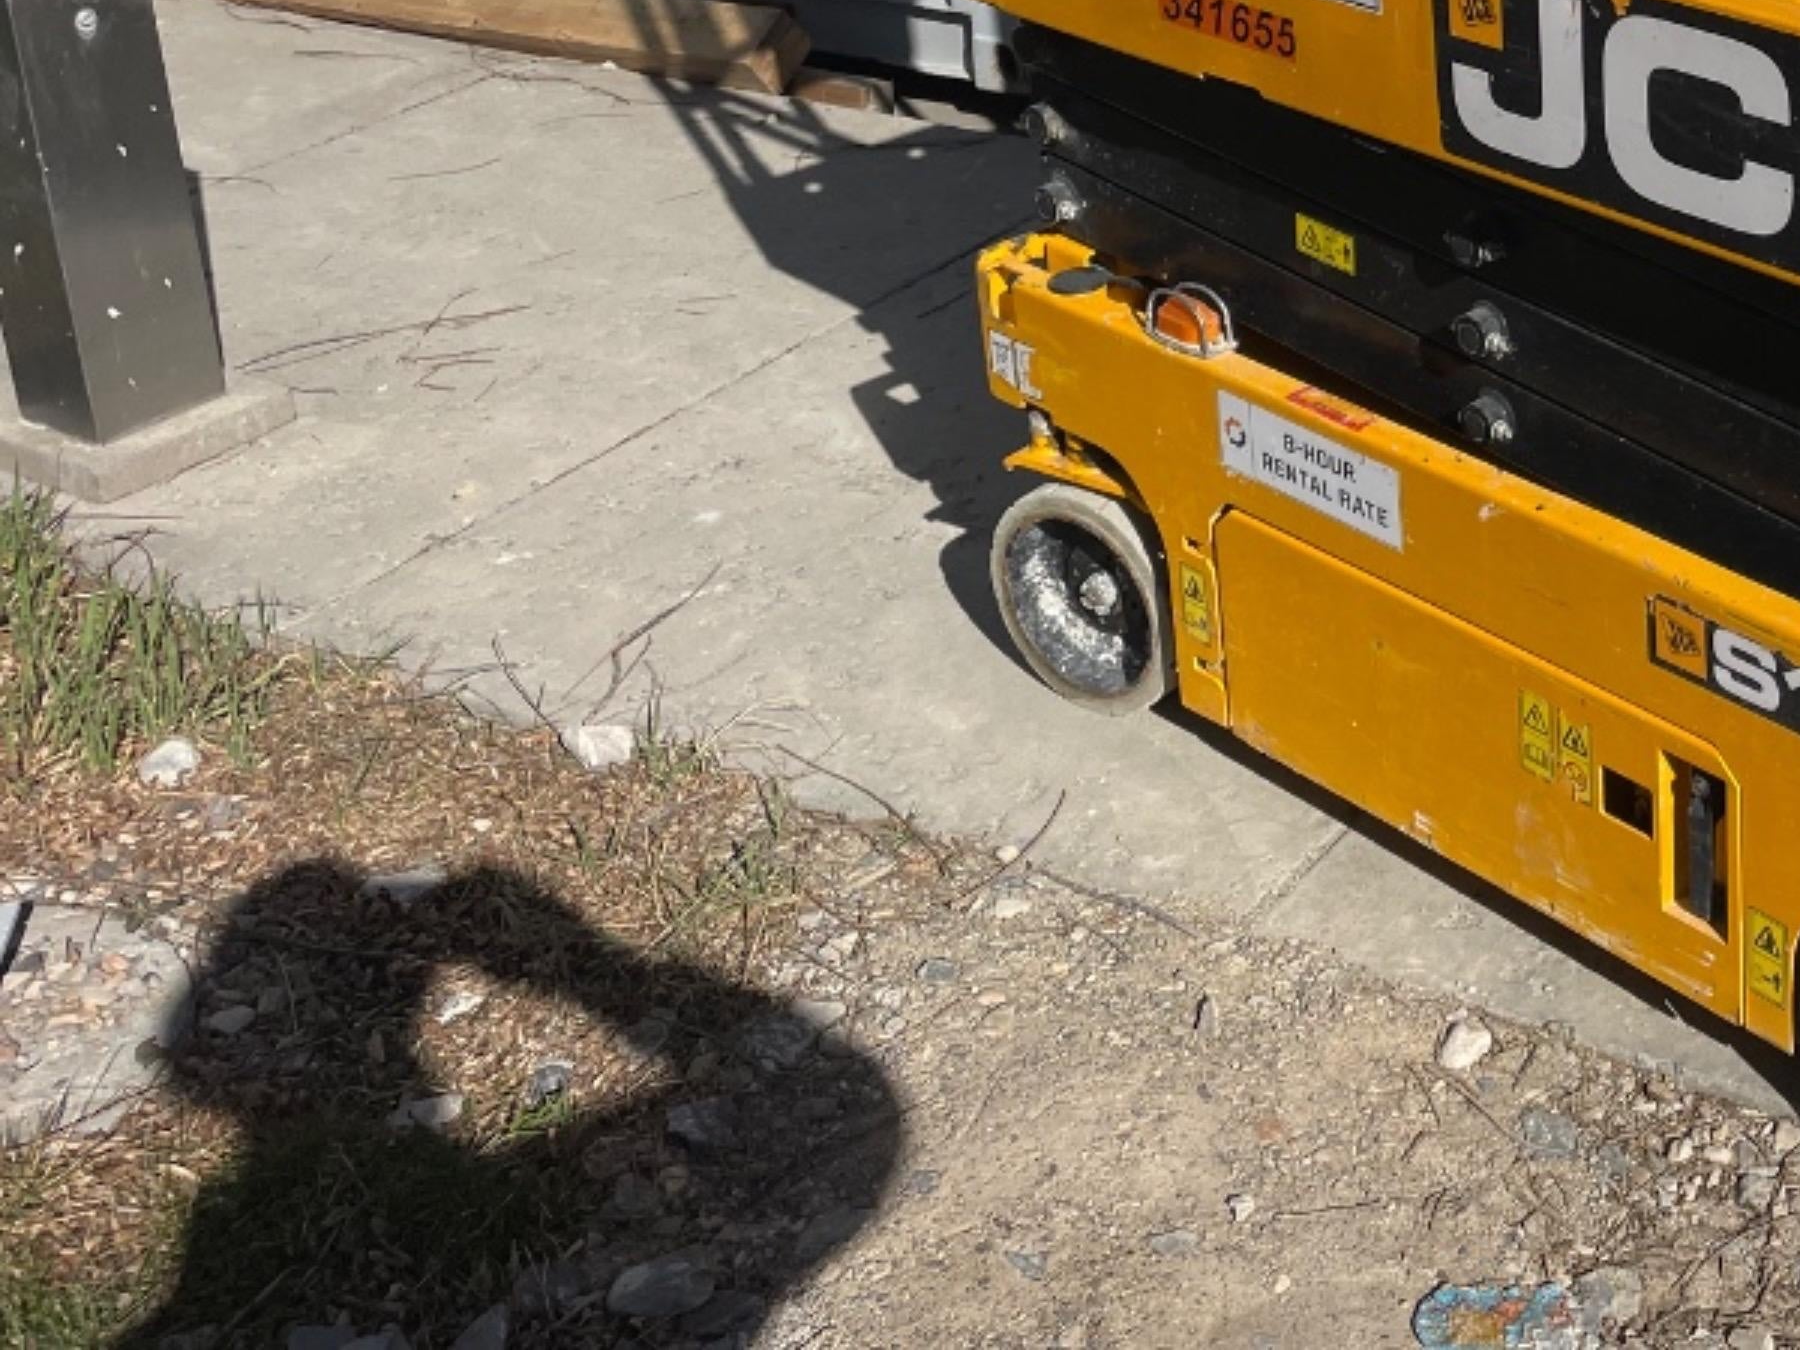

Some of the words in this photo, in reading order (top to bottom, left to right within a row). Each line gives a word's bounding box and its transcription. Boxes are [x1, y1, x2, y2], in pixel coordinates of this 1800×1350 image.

[1261, 451, 1333, 502] RENTAL
[1337, 487, 1390, 529] RATE
[1282, 433, 1357, 484] 8-HOUR
